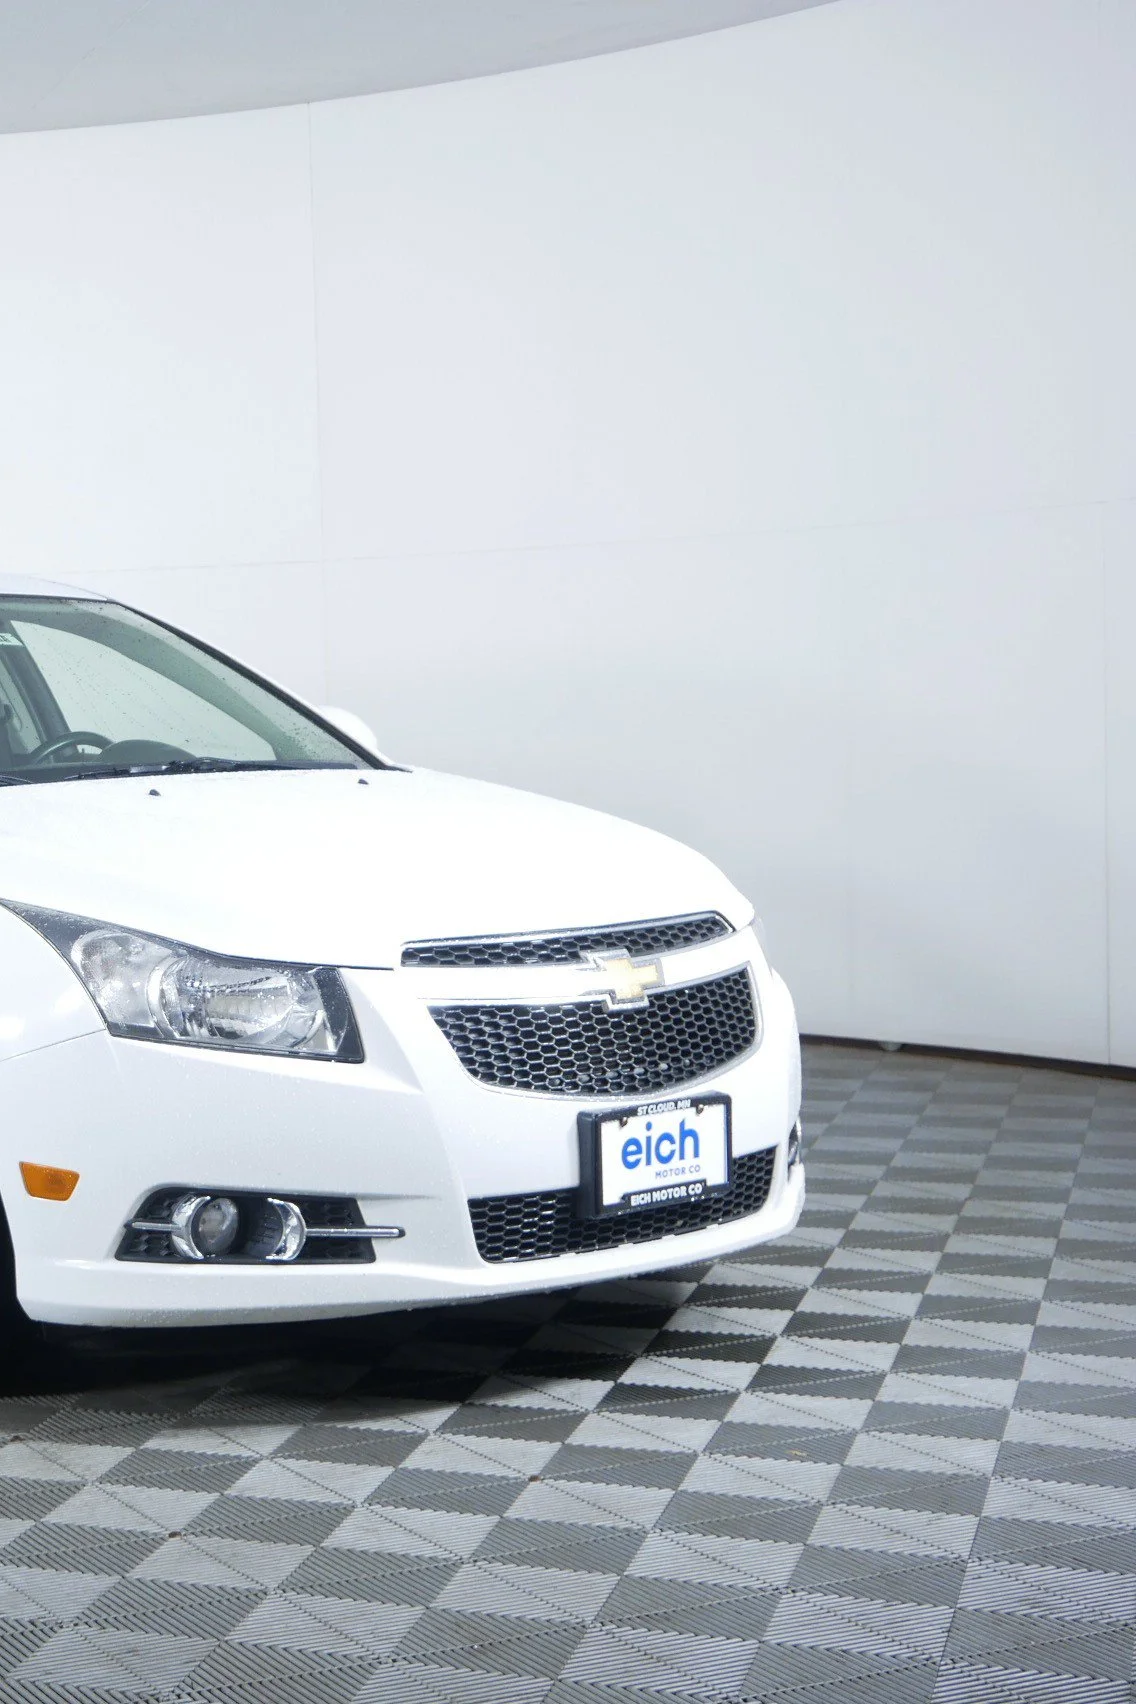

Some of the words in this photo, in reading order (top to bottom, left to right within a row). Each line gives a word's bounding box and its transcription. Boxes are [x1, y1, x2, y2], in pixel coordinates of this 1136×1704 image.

[637, 1106, 647, 1115] ST
[677, 1099, 691, 1110] MN
[621, 1118, 700, 1170] eich
[655, 1167, 686, 1179] MOTOR
[688, 1164, 701, 1174] CO
[630, 1192, 651, 1207] EICH
[652, 1185, 687, 1203] MOTOR
[688, 1183, 703, 1196] CO
